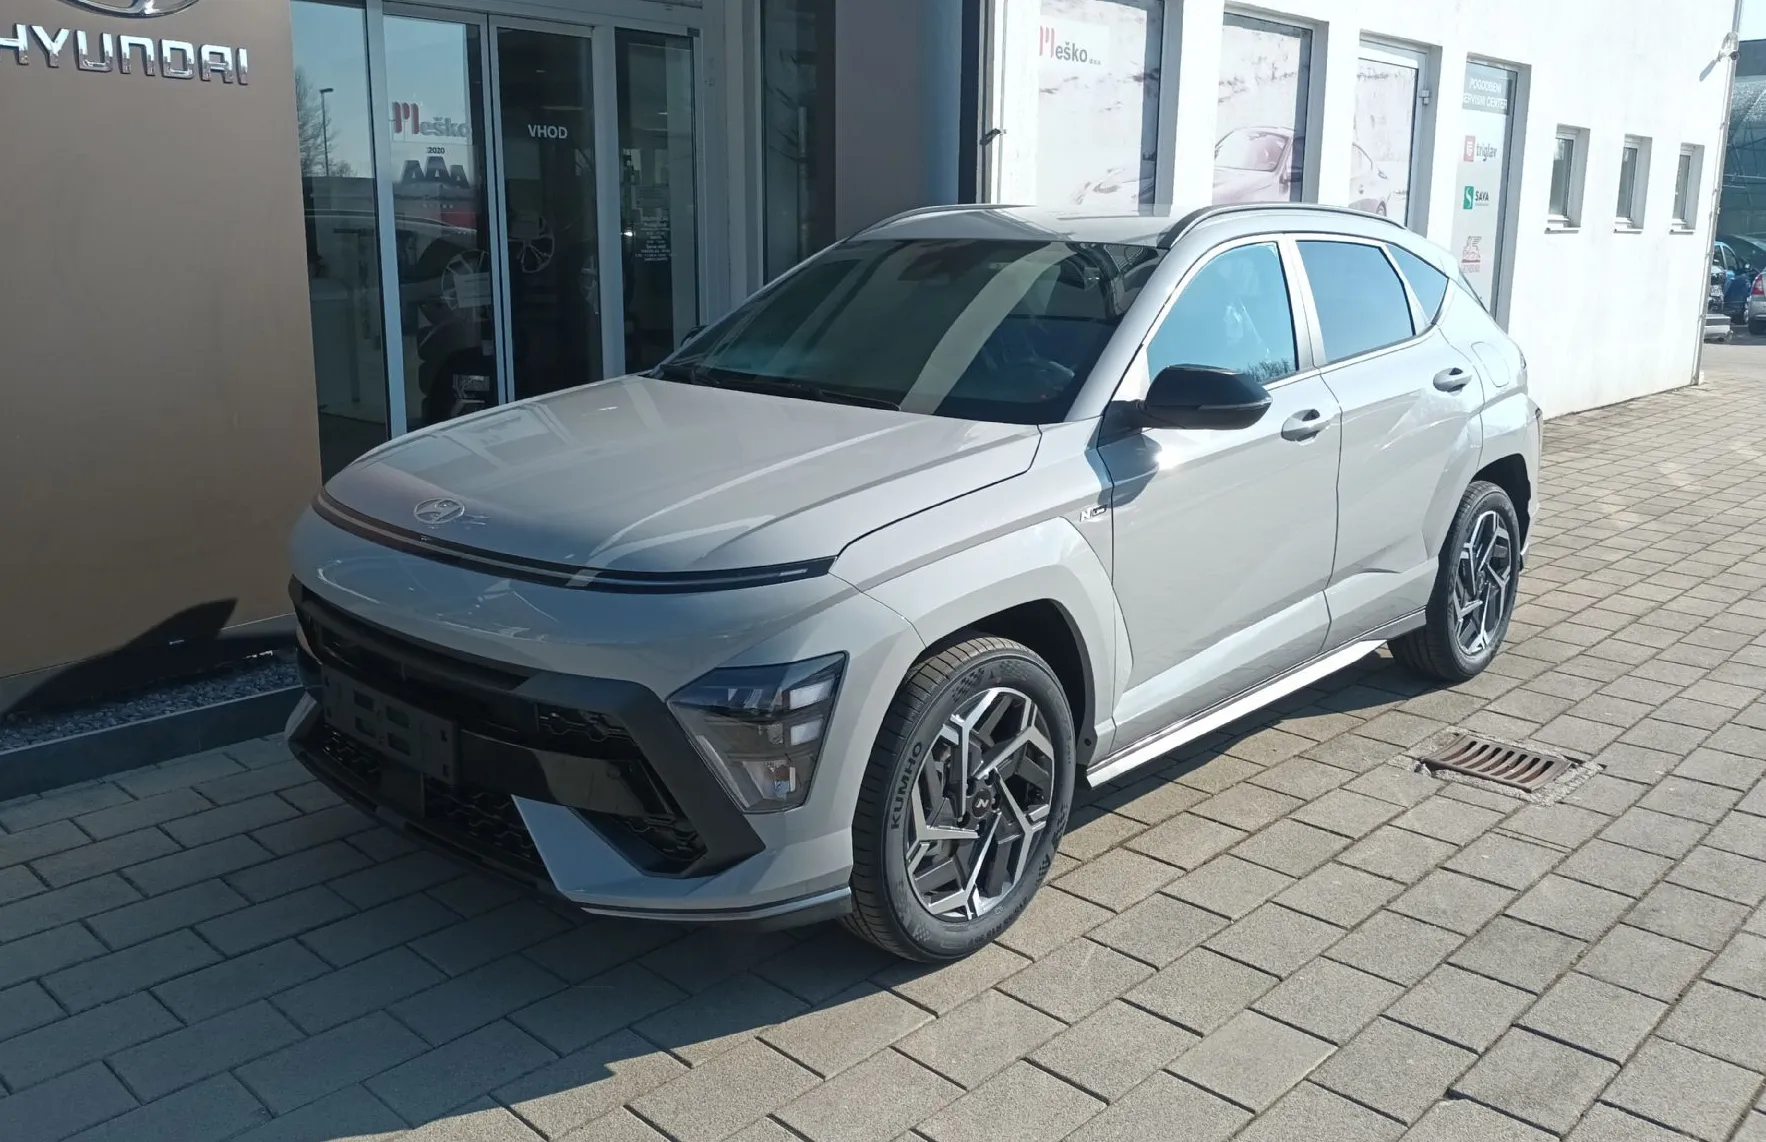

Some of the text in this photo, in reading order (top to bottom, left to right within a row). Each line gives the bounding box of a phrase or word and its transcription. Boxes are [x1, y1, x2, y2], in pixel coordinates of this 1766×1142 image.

[0, 22, 249, 85] HYUNDAI
[527, 123, 568, 139] VHOD
[428, 146, 446, 155] 2020
[1476, 142, 1497, 162] triglav
[1475, 190, 1490, 202] SAVA
[890, 741, 923, 830] KUMHO
